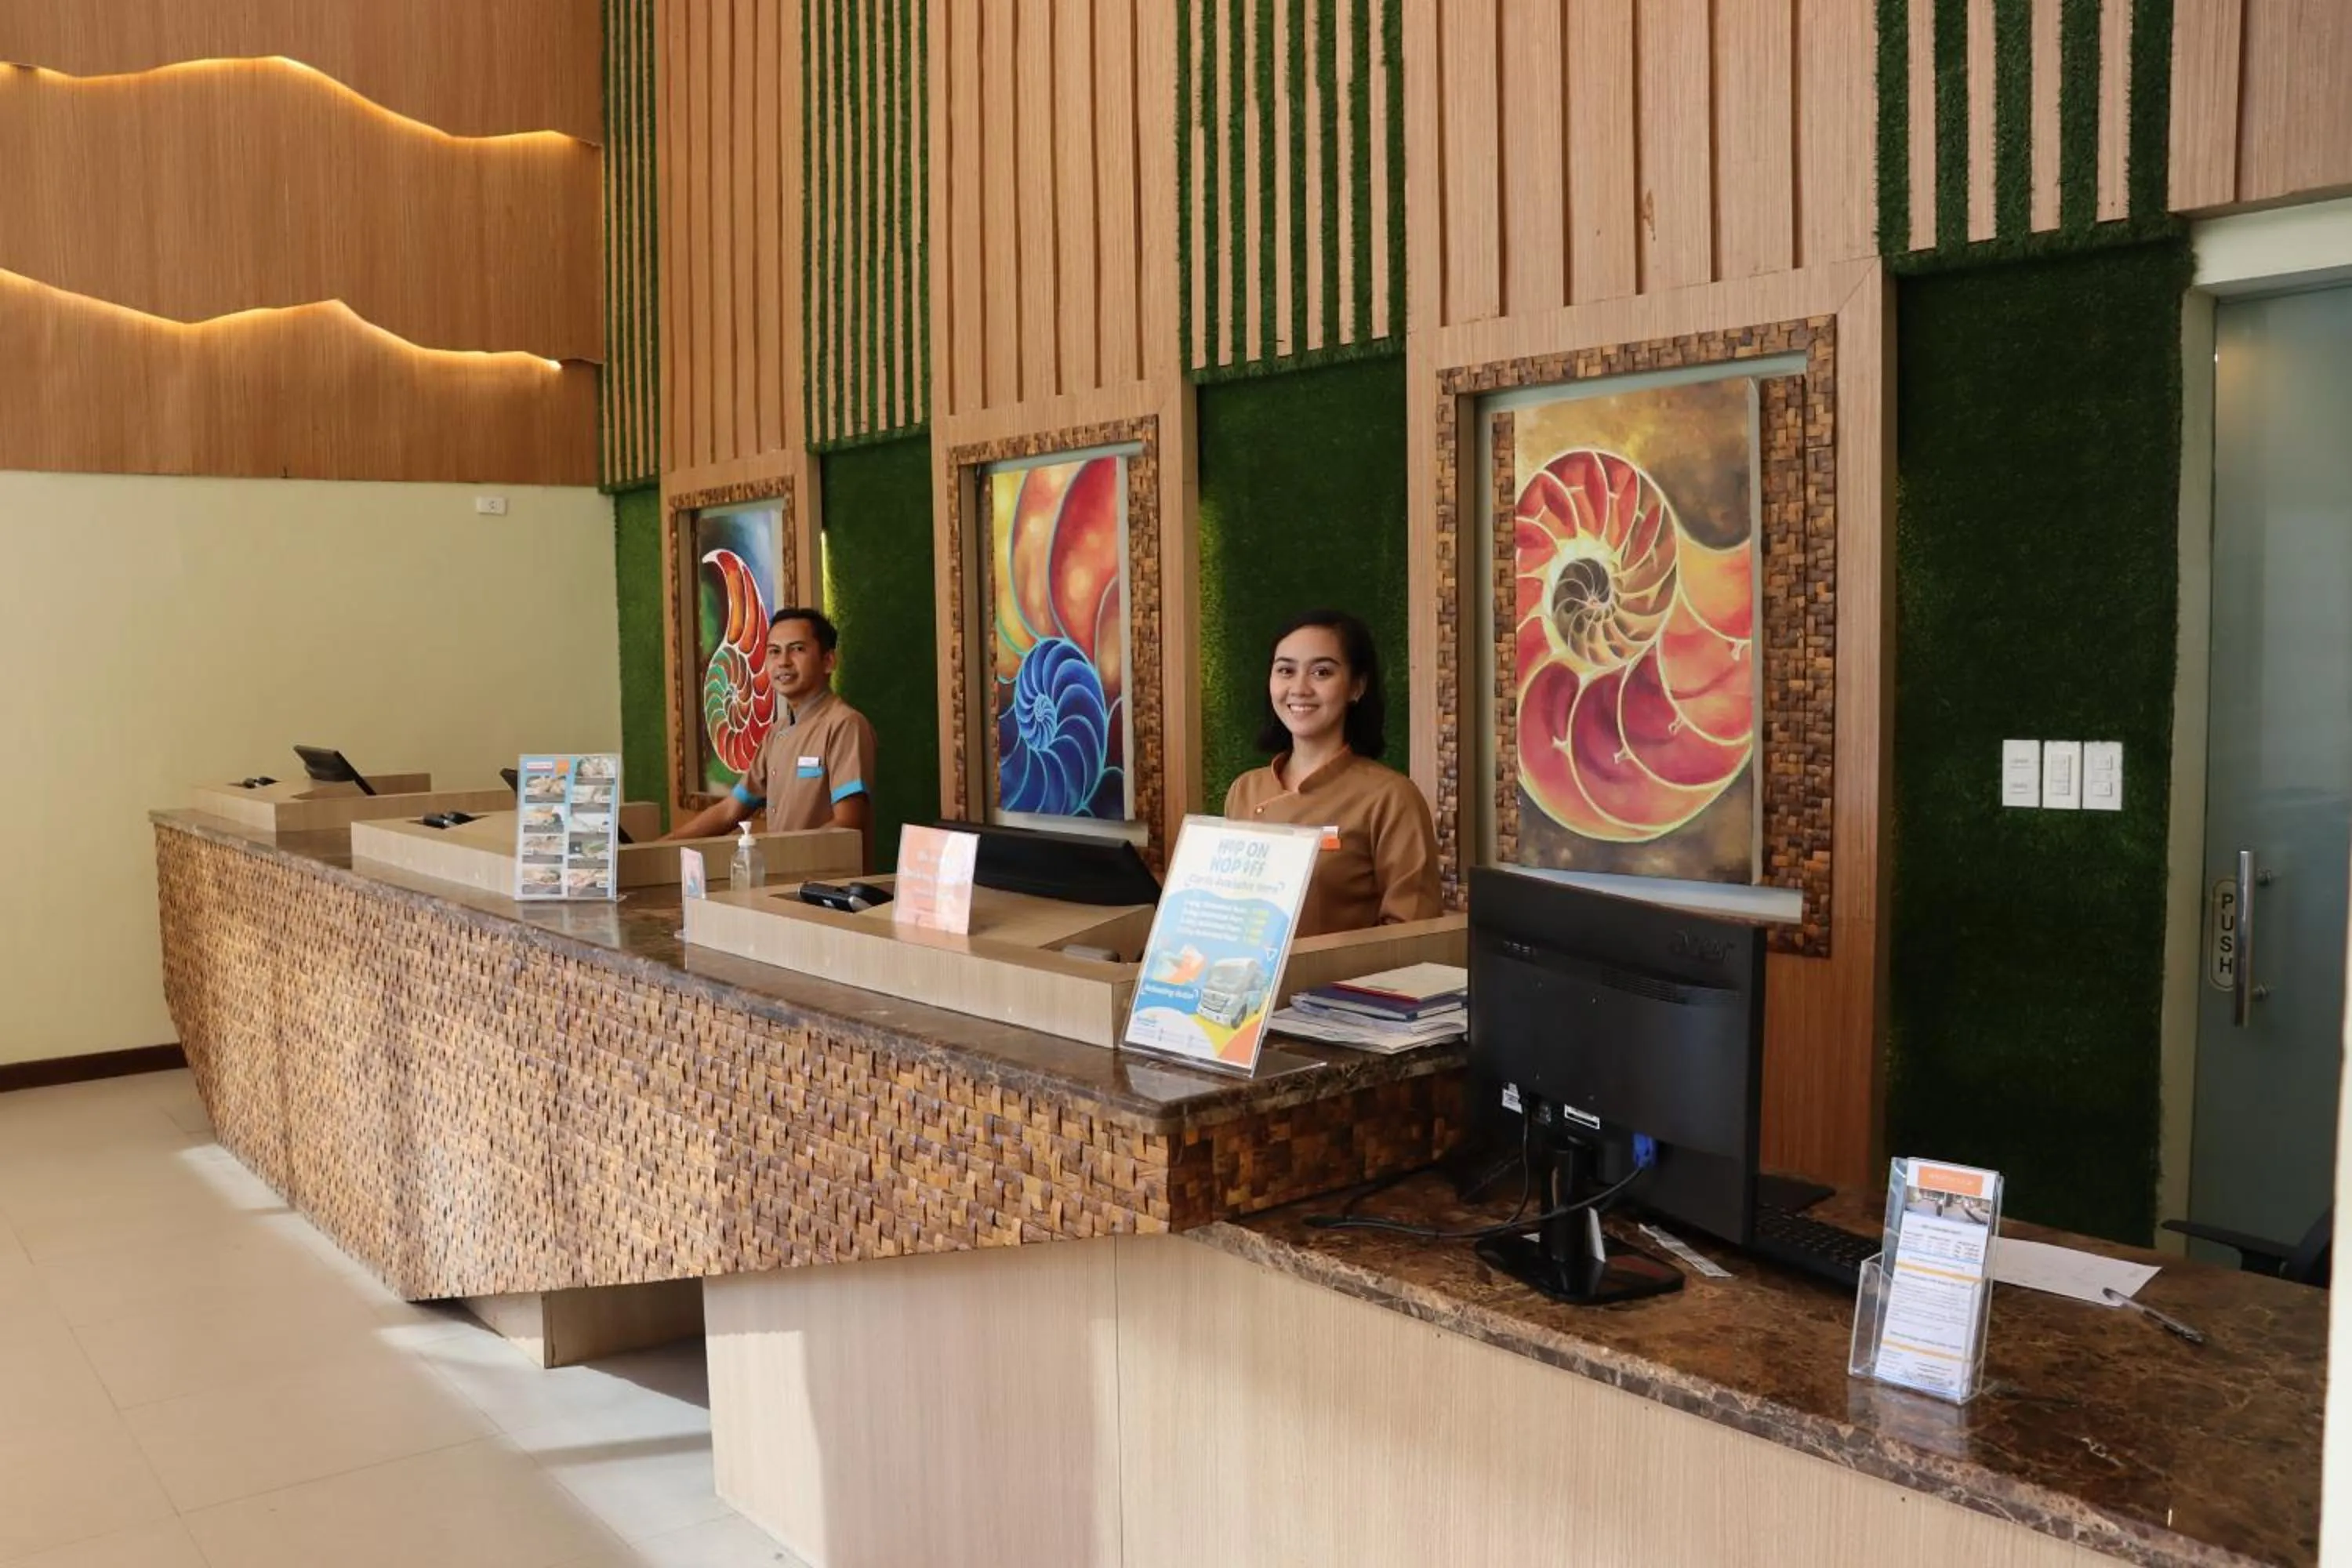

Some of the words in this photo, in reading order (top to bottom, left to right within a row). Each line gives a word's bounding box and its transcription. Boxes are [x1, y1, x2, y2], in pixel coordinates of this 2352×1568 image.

[1247, 841, 1270, 858] ON
[1210, 855, 1242, 874] HOP
[2220, 892, 2234, 974] PUSH
